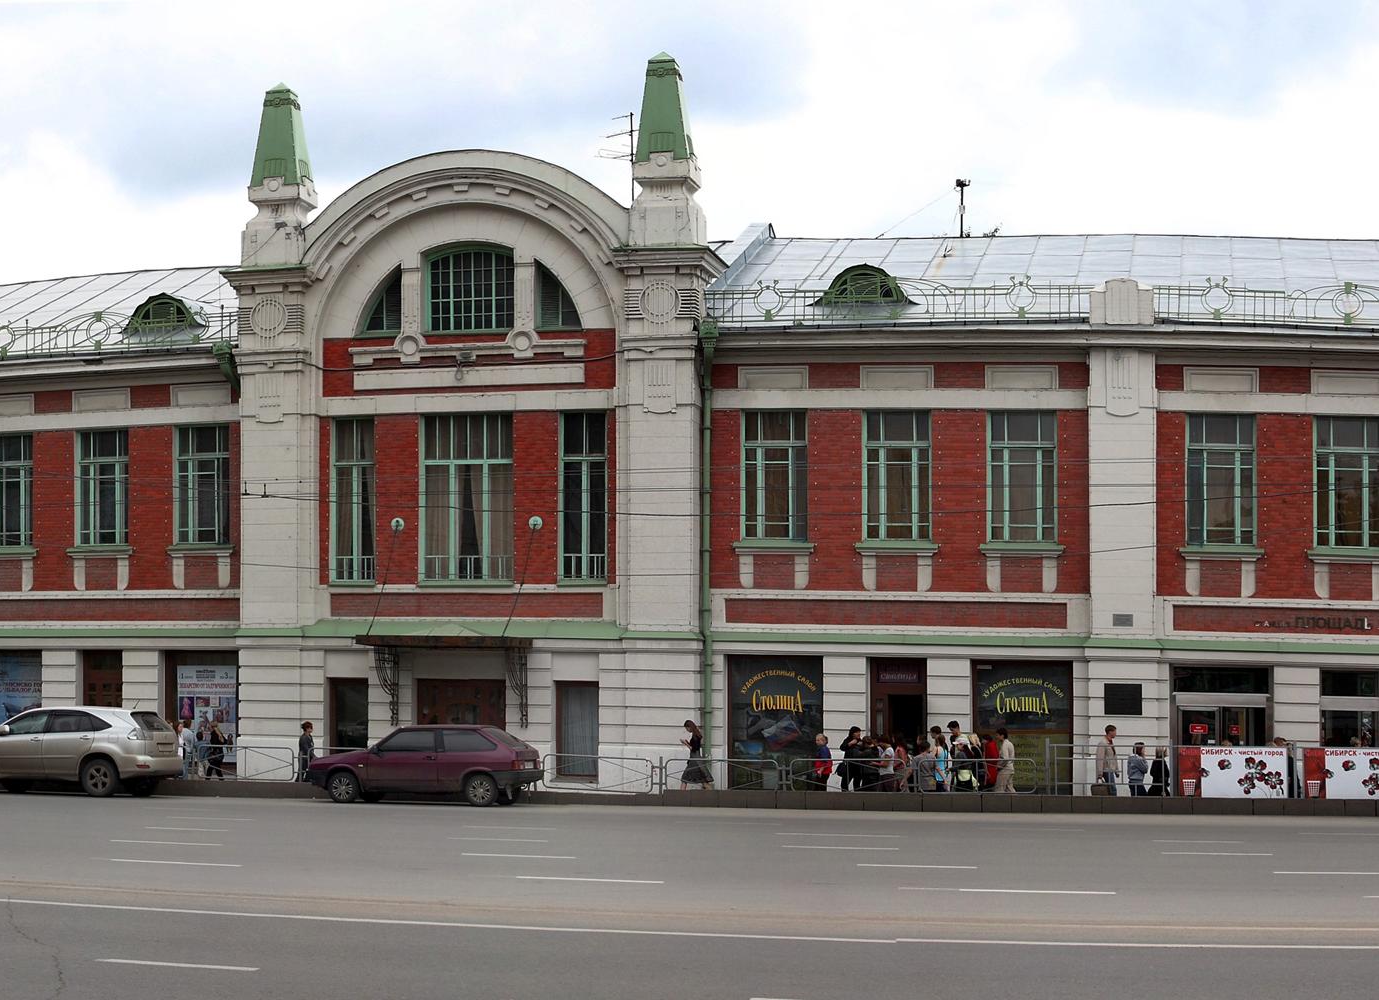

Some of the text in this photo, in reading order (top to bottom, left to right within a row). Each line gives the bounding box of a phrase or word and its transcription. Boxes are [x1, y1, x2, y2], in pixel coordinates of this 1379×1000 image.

[797, 675, 817, 692] САЛОН
[982, 677, 1064, 698] ХУДОЖЕСТВЕННЫЙ САЛОН
